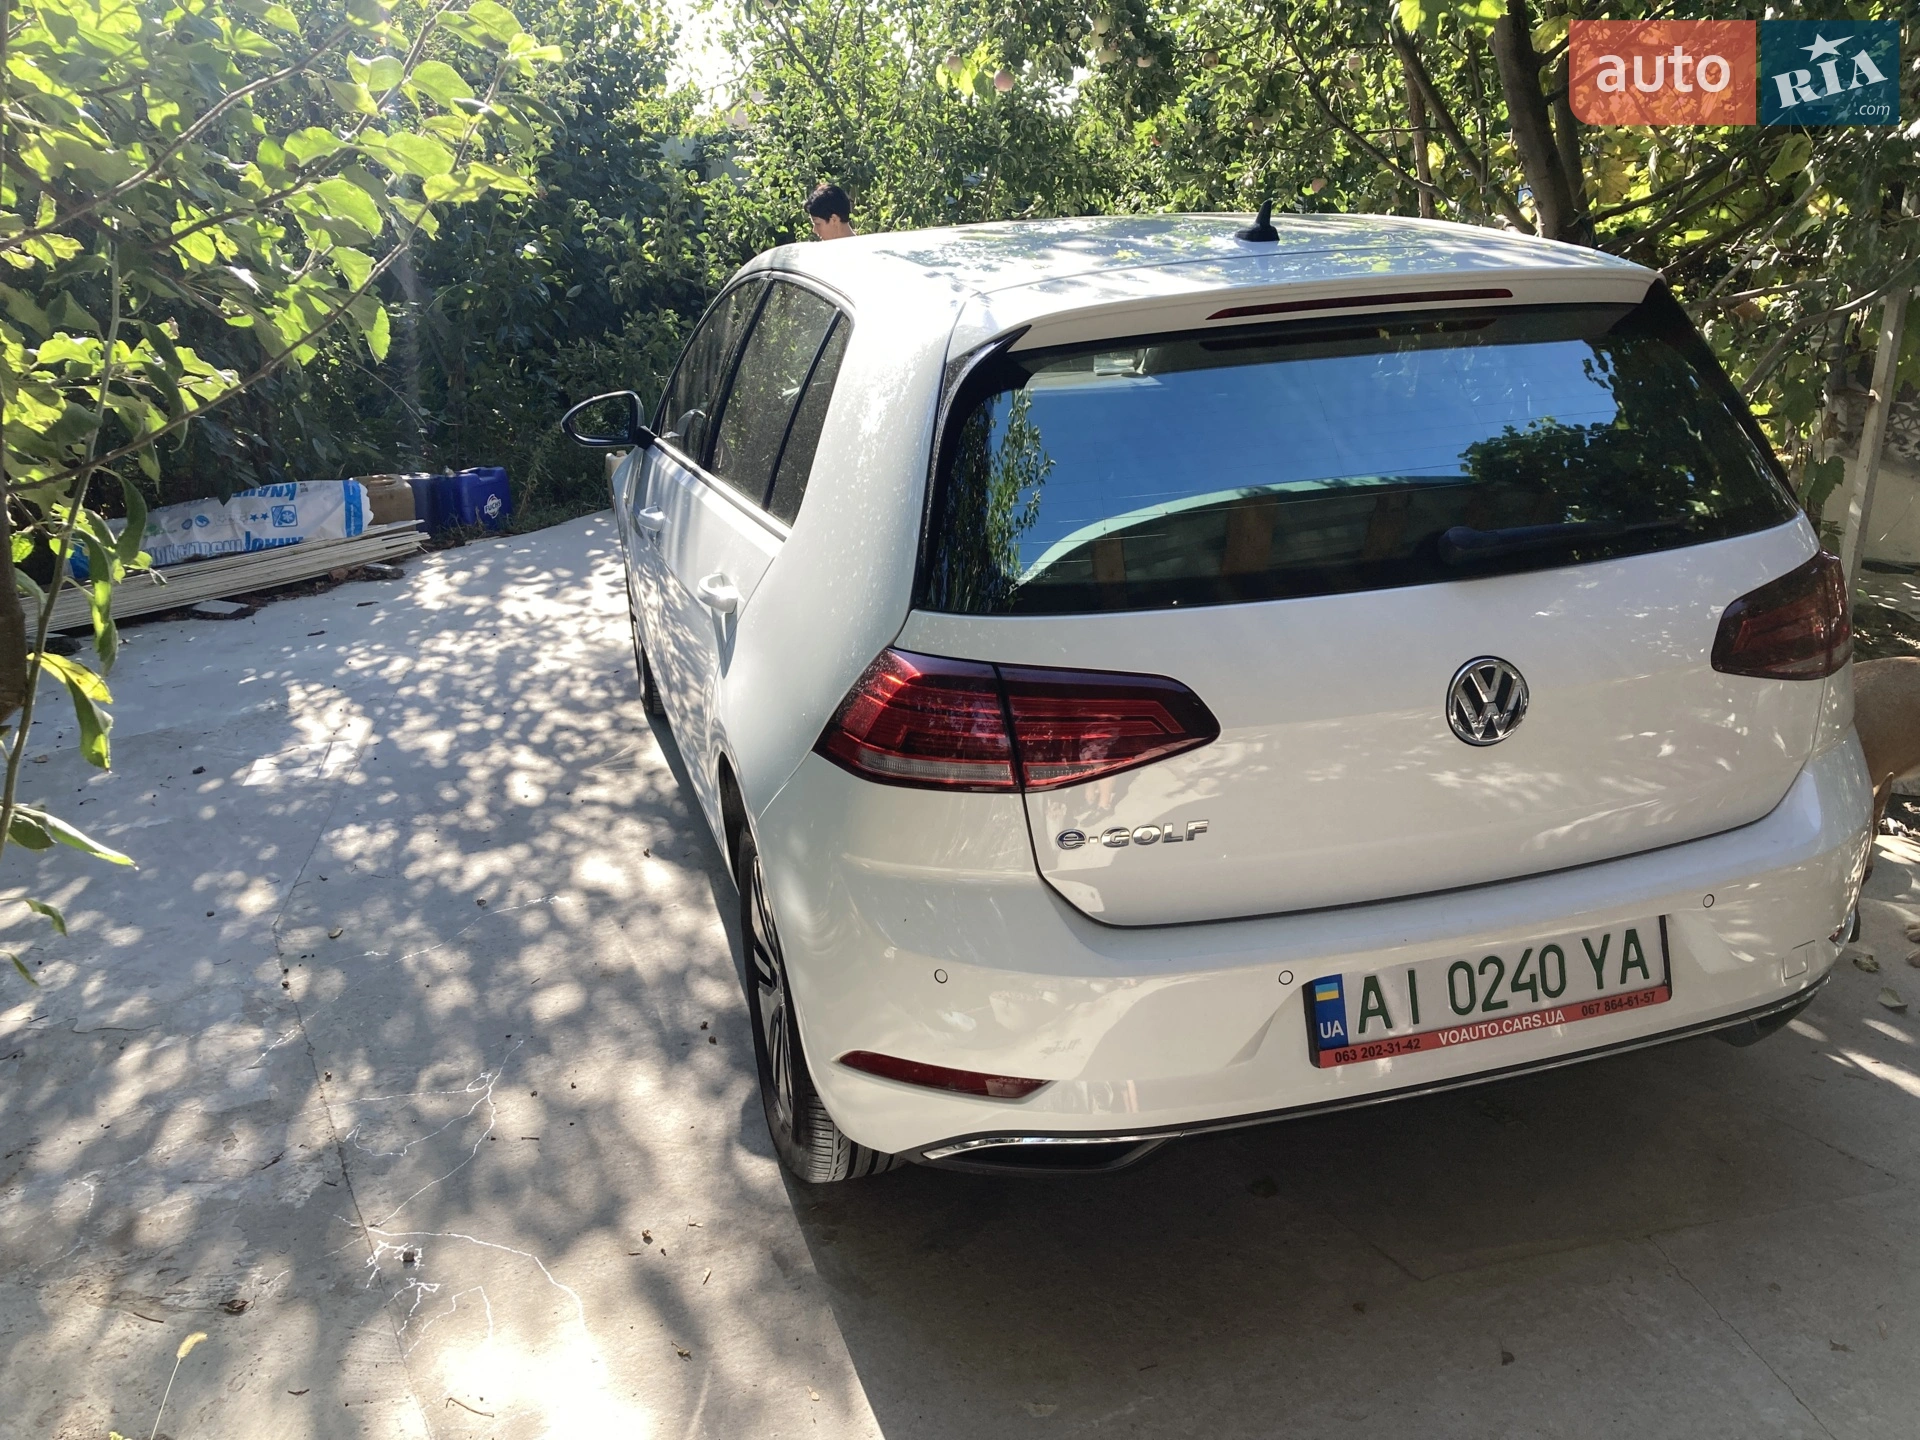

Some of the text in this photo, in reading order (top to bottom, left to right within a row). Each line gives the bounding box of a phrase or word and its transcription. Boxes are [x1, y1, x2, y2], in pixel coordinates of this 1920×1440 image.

[1056, 820, 1209, 850] e-GOLF
[1319, 928, 1650, 1040] UA AI 0240 YA
[1334, 990, 1656, 1064] 063 202-31-42 VOAUTO.CARS.UA 067 864-61-57
